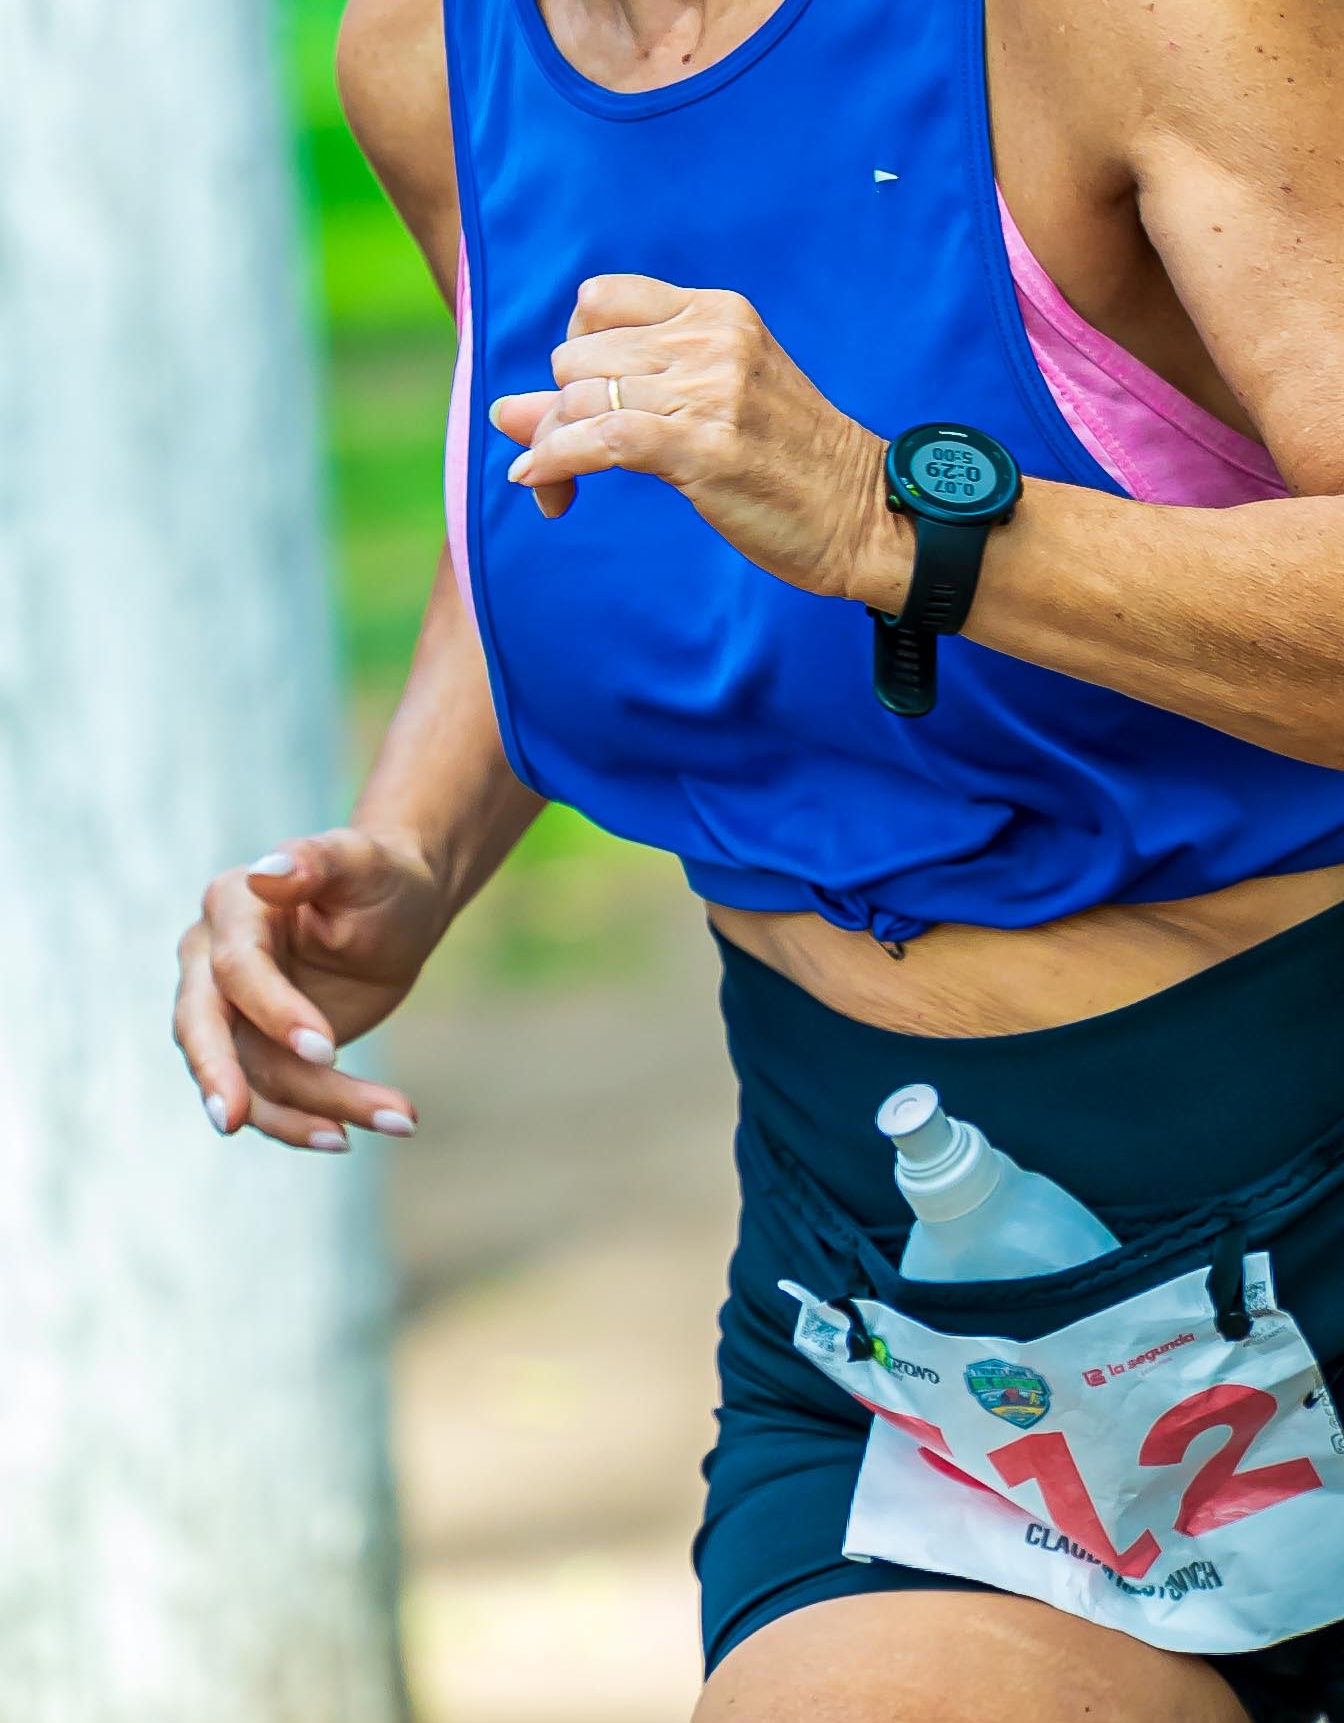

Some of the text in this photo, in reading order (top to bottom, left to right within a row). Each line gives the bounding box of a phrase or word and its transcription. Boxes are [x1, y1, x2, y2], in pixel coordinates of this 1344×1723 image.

[925, 461, 983, 483] 0:29
[933, 479, 976, 497] 0.07
[1107, 1364, 1125, 1376] la
[1127, 1333, 1196, 1369] segunda
[853, 1383, 1324, 1579] 12
